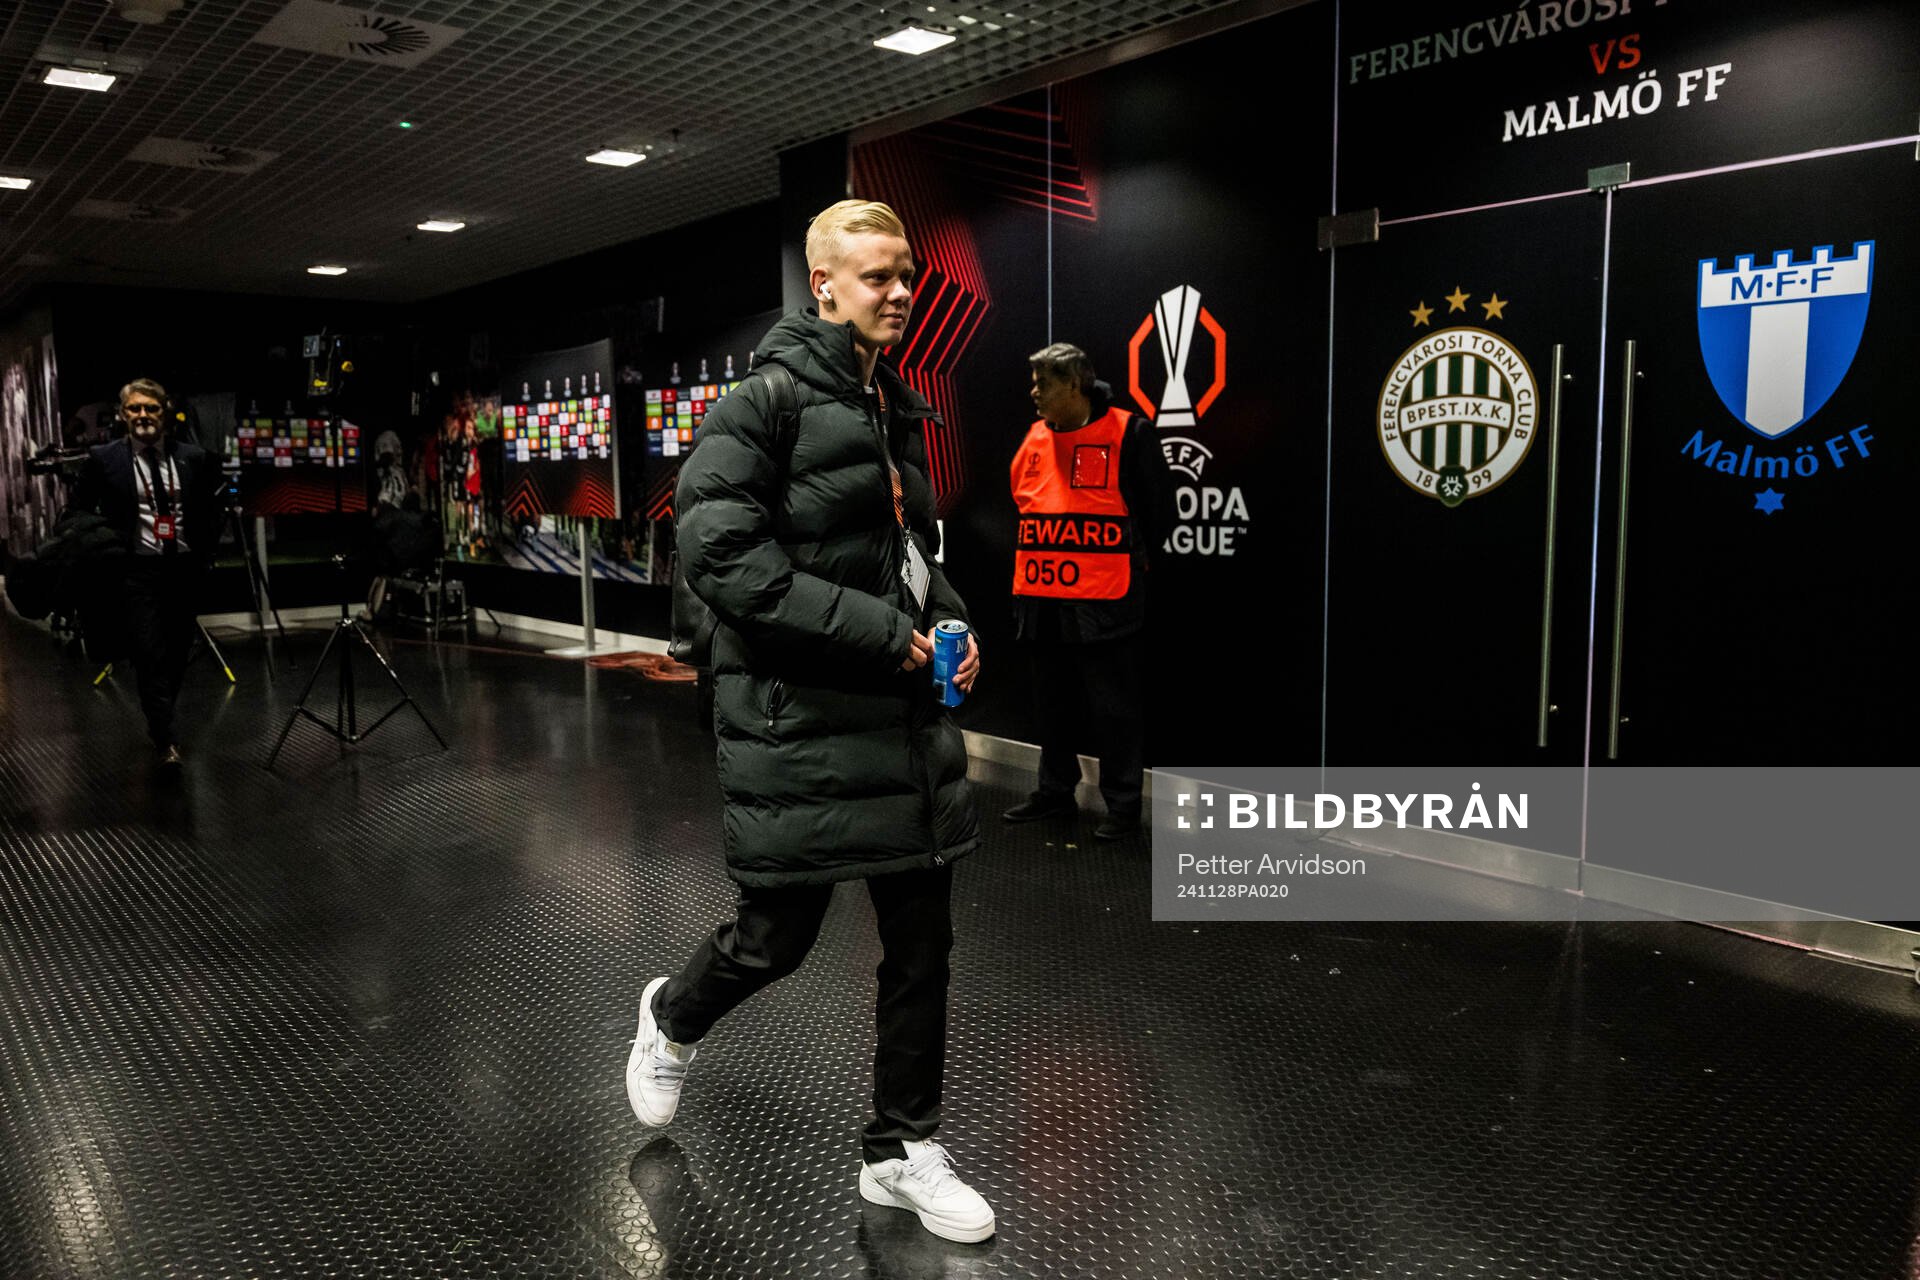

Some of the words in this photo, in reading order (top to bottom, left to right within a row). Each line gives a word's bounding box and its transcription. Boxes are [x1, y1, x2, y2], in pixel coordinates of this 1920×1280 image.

[1589, 33, 1641, 75] VS
[1502, 70, 1662, 142] MALMÖ
[1676, 62, 1732, 107] FF
[1383, 335, 1463, 442] FERENCVÁROSI
[1471, 335, 1524, 384] TORNA
[1513, 388, 1533, 440] CLUB
[1680, 429, 1820, 479] Malmö
[1824, 423, 1875, 469] FF
